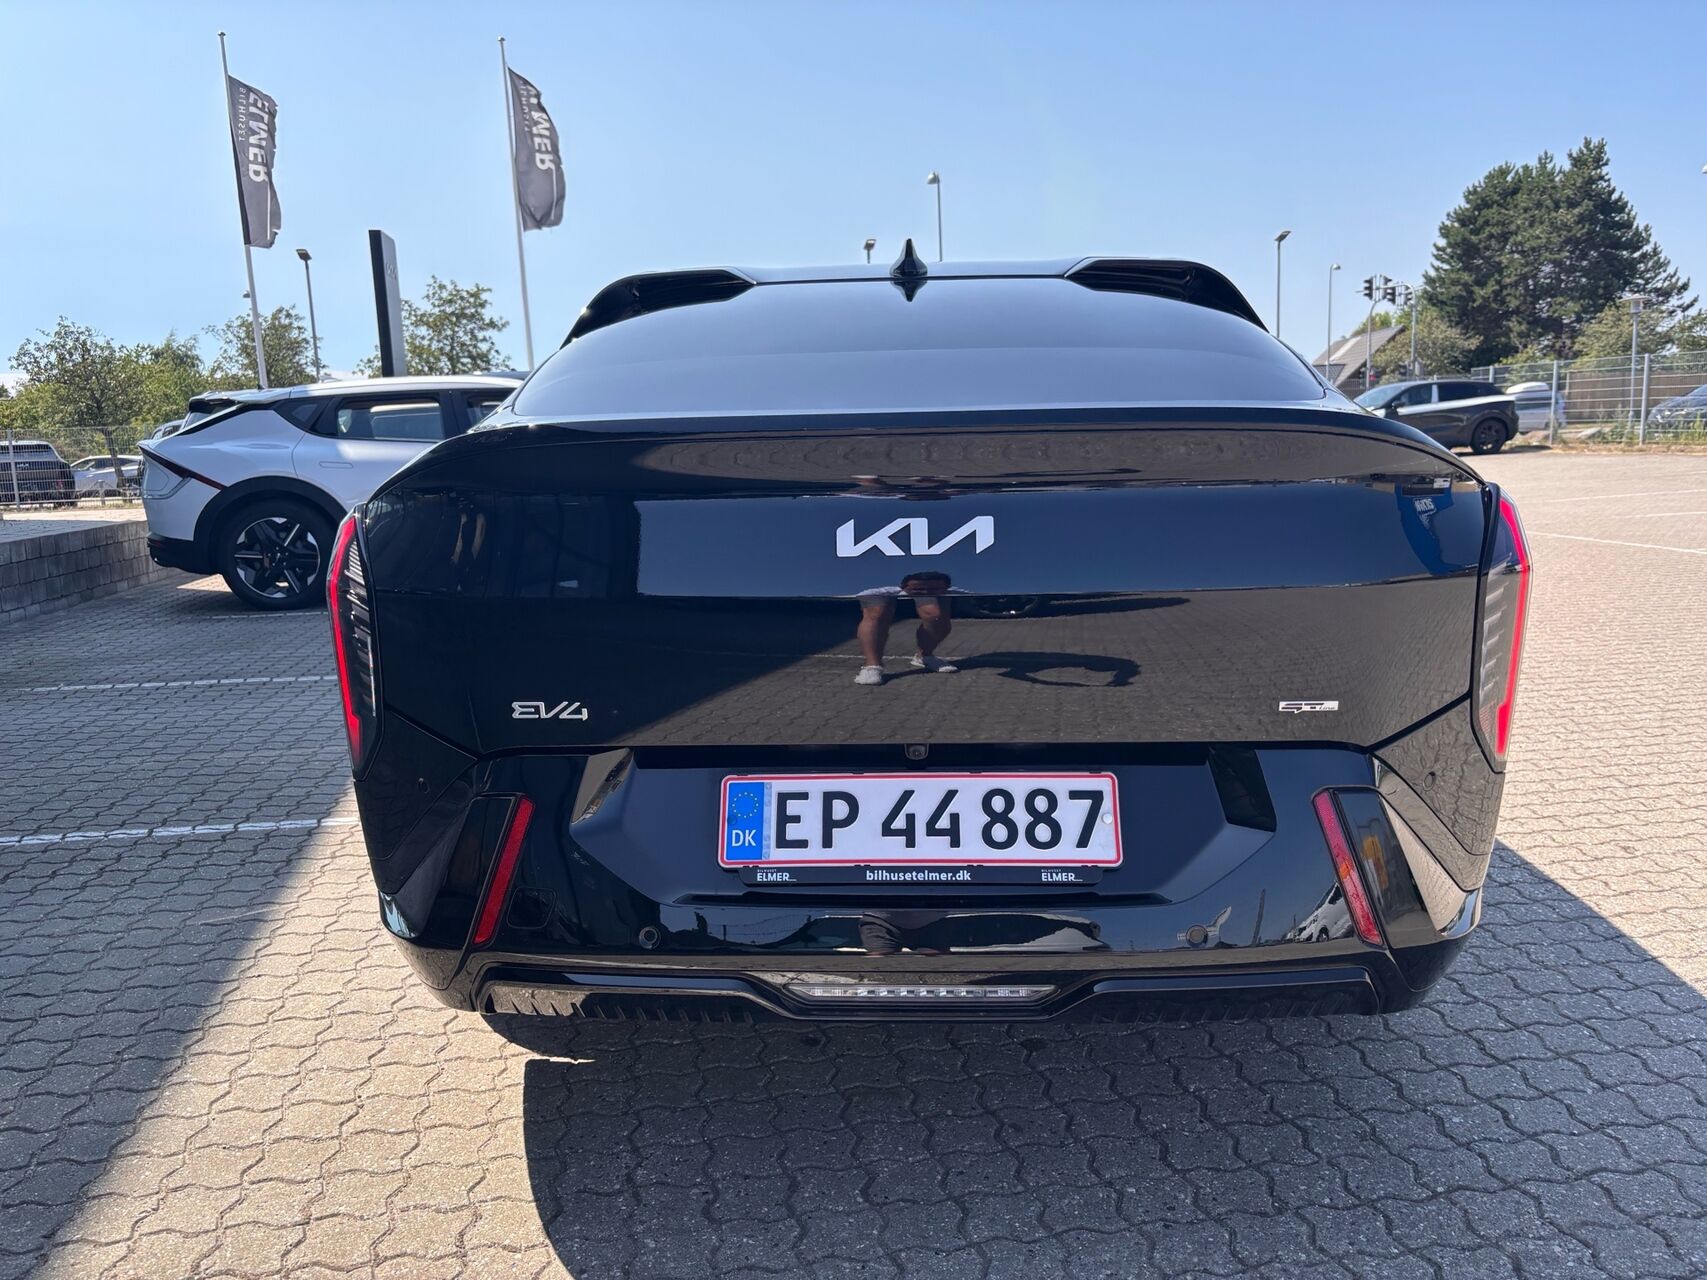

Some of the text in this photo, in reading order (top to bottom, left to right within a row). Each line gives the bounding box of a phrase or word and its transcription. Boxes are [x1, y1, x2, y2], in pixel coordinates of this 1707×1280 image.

[836, 515, 995, 558] KIA
[511, 701, 589, 721] EV4
[775, 787, 1104, 851] EP 44 887
[731, 829, 757, 847] DK
[756, 872, 790, 882] ELMER
[865, 869, 972, 881] bilhusetelmer.dk
[1041, 872, 1075, 882] ELMER
